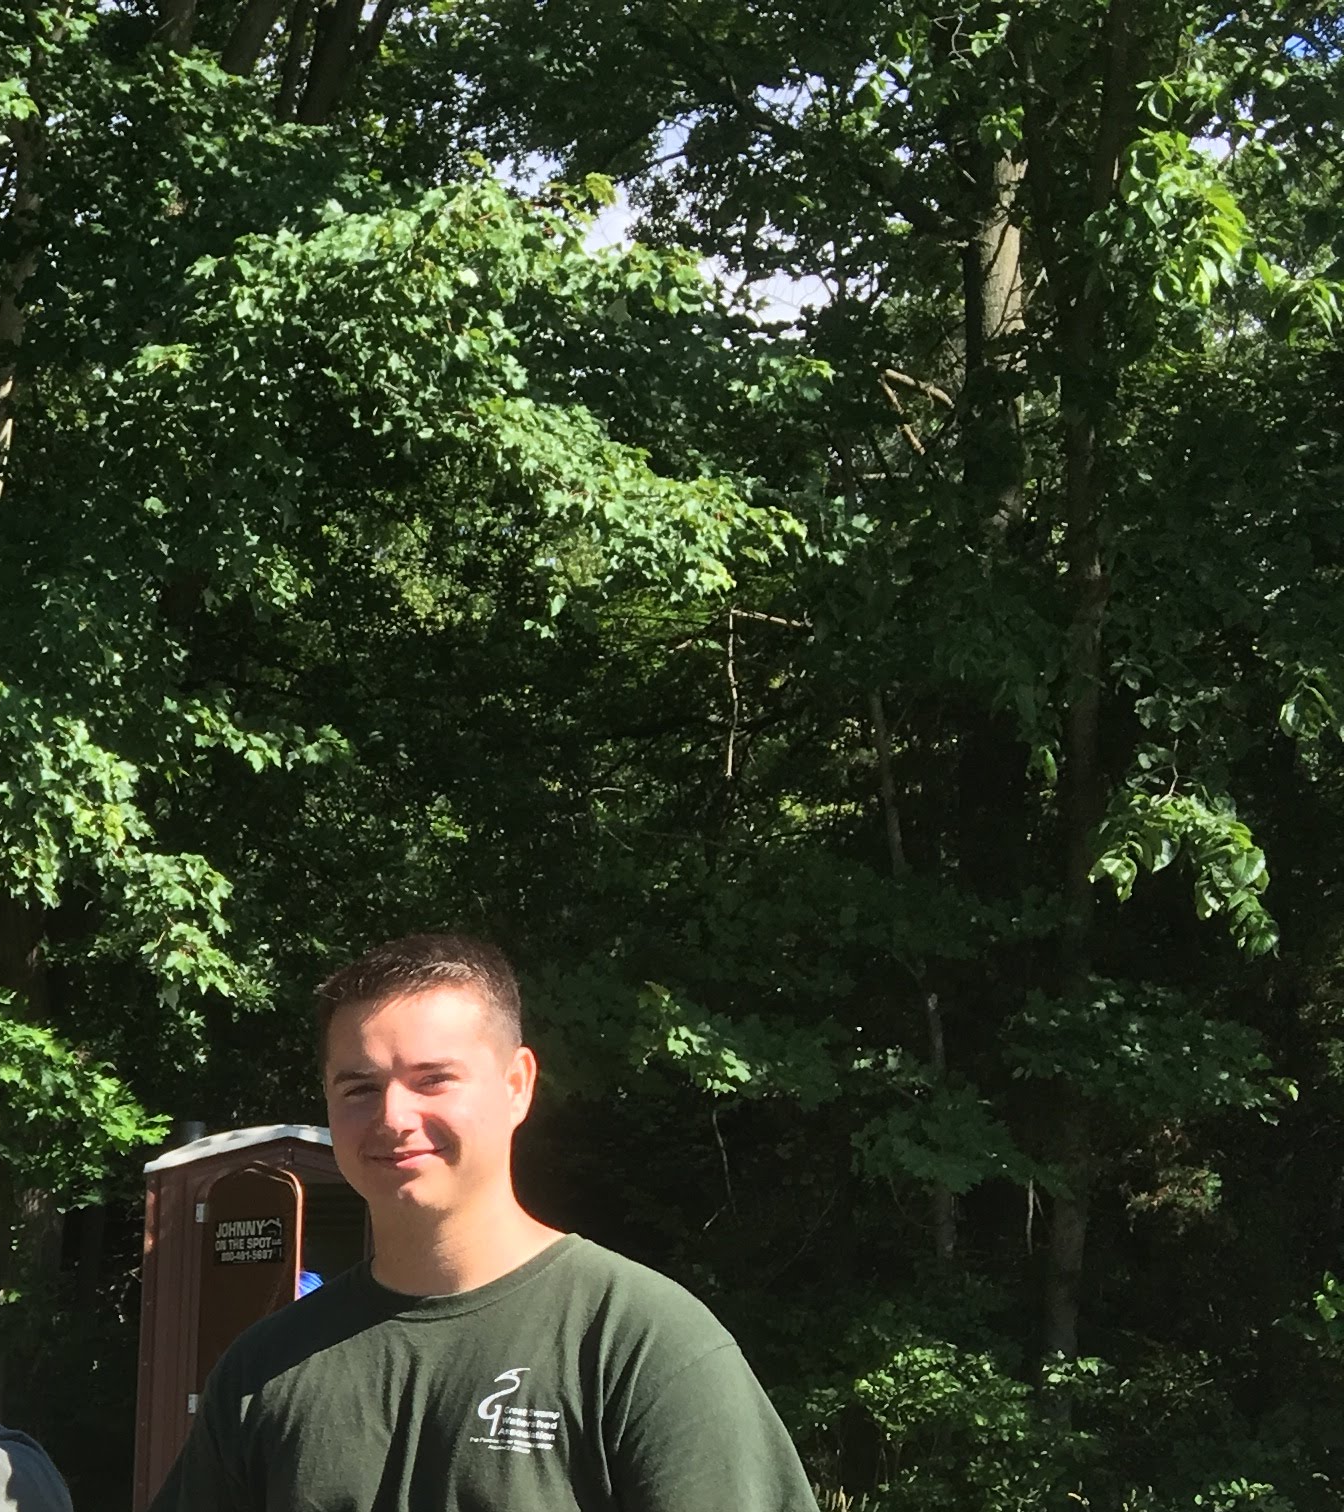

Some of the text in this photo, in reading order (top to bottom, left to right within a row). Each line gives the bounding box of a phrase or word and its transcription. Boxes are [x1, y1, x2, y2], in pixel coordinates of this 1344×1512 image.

[215, 1219, 265, 1238] JOHNNY
[214, 1240, 226, 1251] ON
[228, 1238, 245, 1250] THE
[246, 1236, 272, 1249] SPOT
